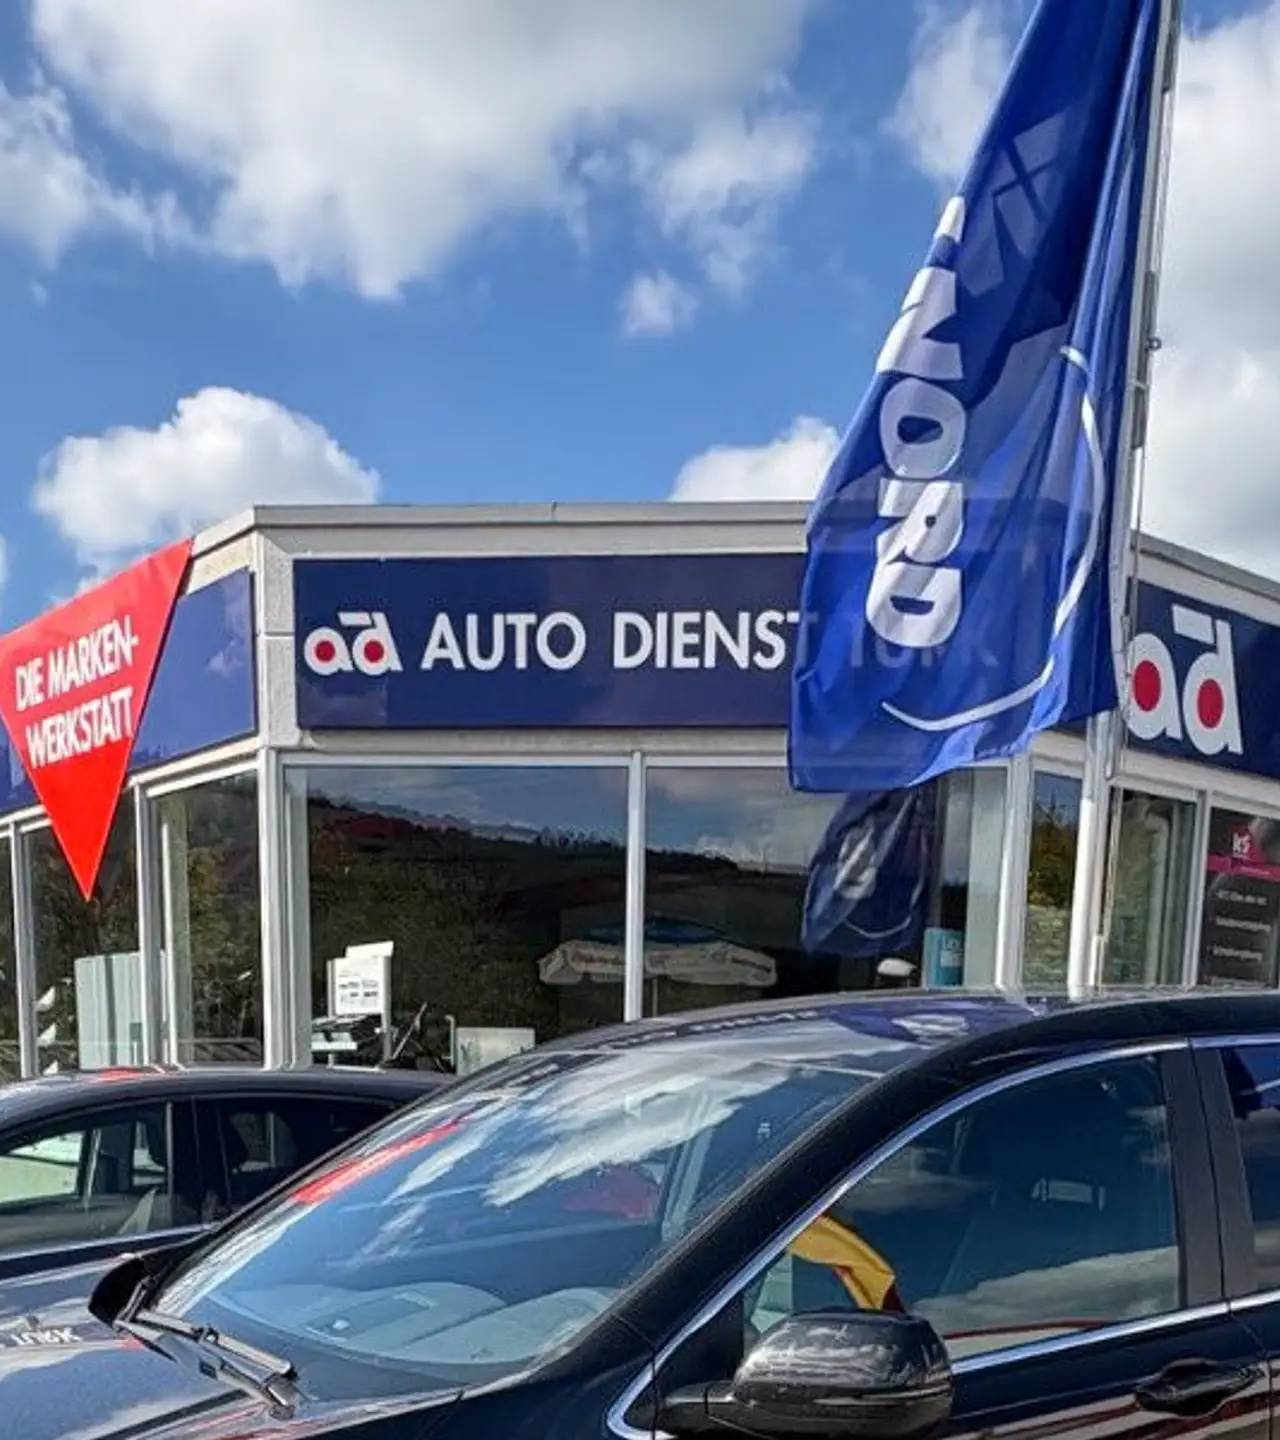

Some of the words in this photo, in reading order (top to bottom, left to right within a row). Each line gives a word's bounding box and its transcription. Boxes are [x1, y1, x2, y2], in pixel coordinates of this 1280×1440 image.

[14, 664, 46, 711] DIE
[47, 615, 139, 700] MARKEN-
[420, 611, 588, 672] AUTO
[24, 686, 136, 769] WERKSTATT
